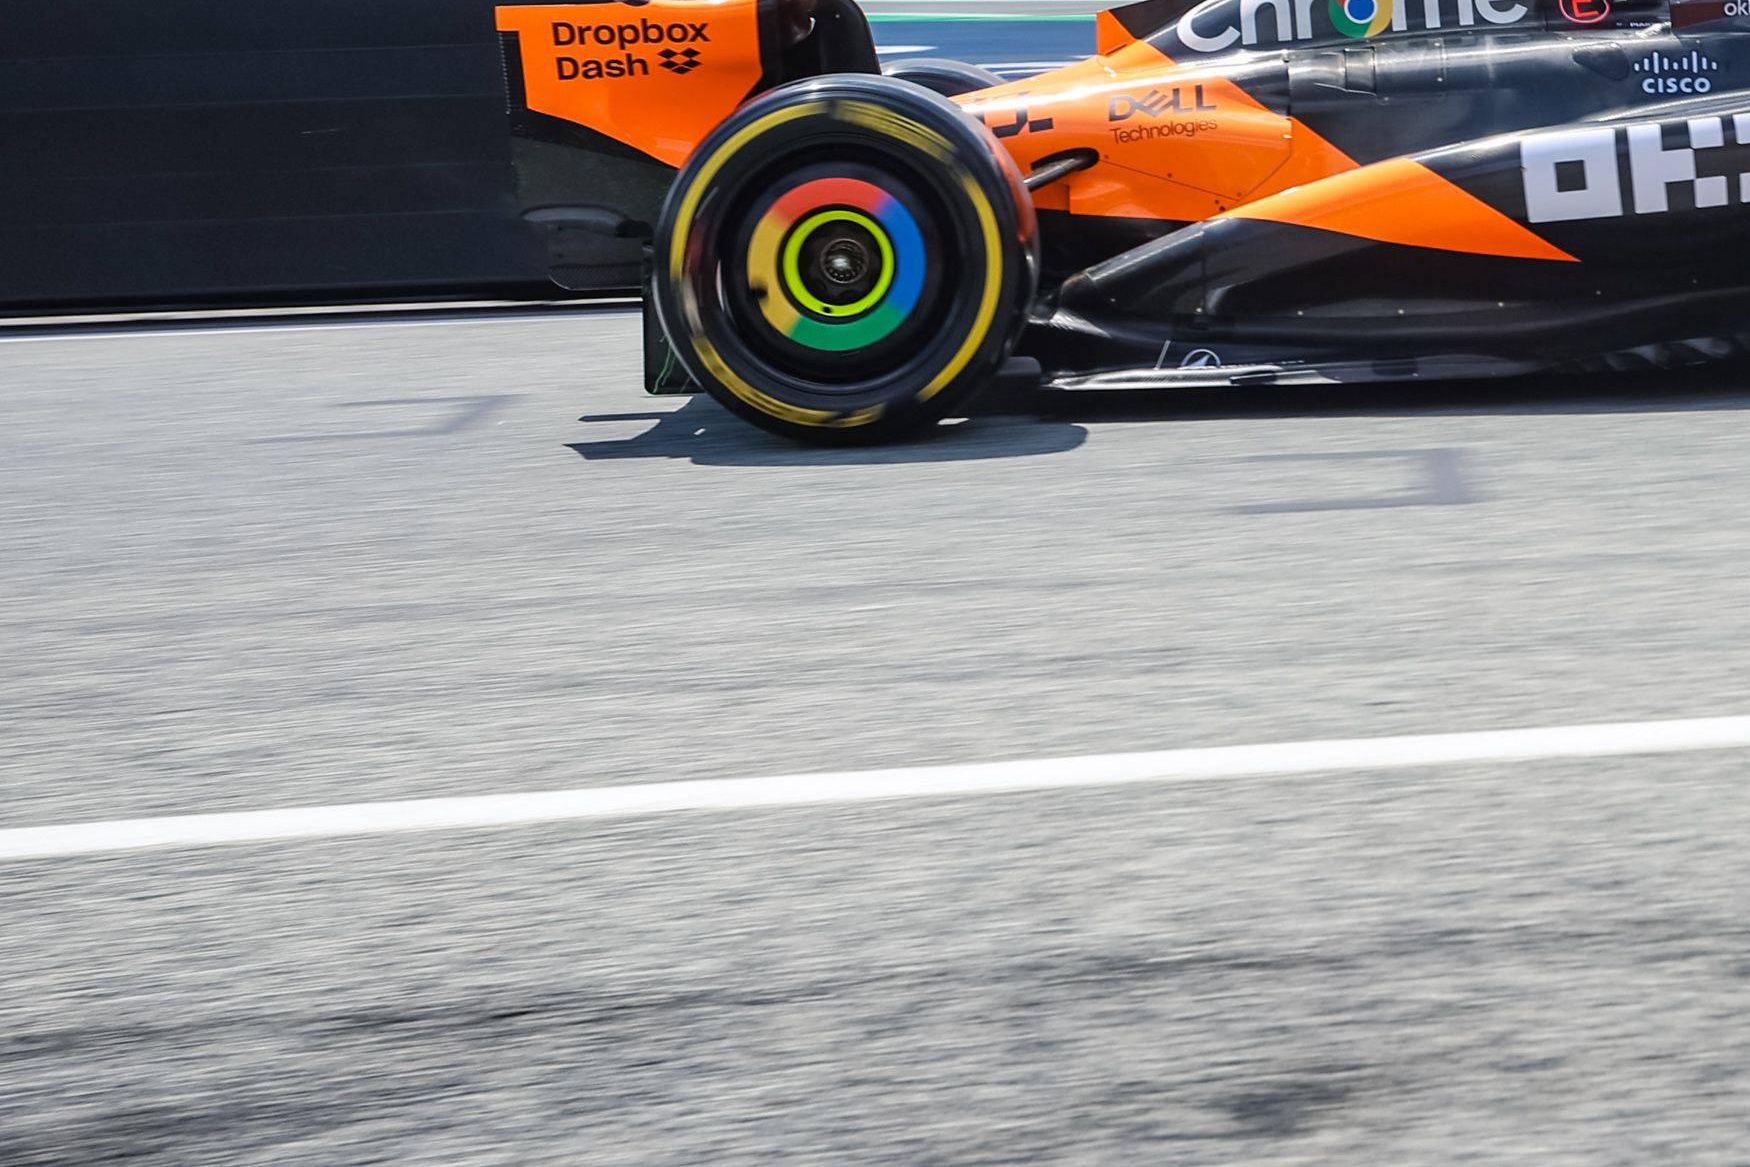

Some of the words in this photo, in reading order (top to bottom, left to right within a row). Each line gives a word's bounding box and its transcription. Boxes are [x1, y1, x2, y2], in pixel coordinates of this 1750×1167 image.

[552, 18, 711, 50] Dropbox
[556, 53, 649, 80] Dash
[1109, 84, 1217, 122] DELL
[1109, 119, 1218, 144] Technologies
